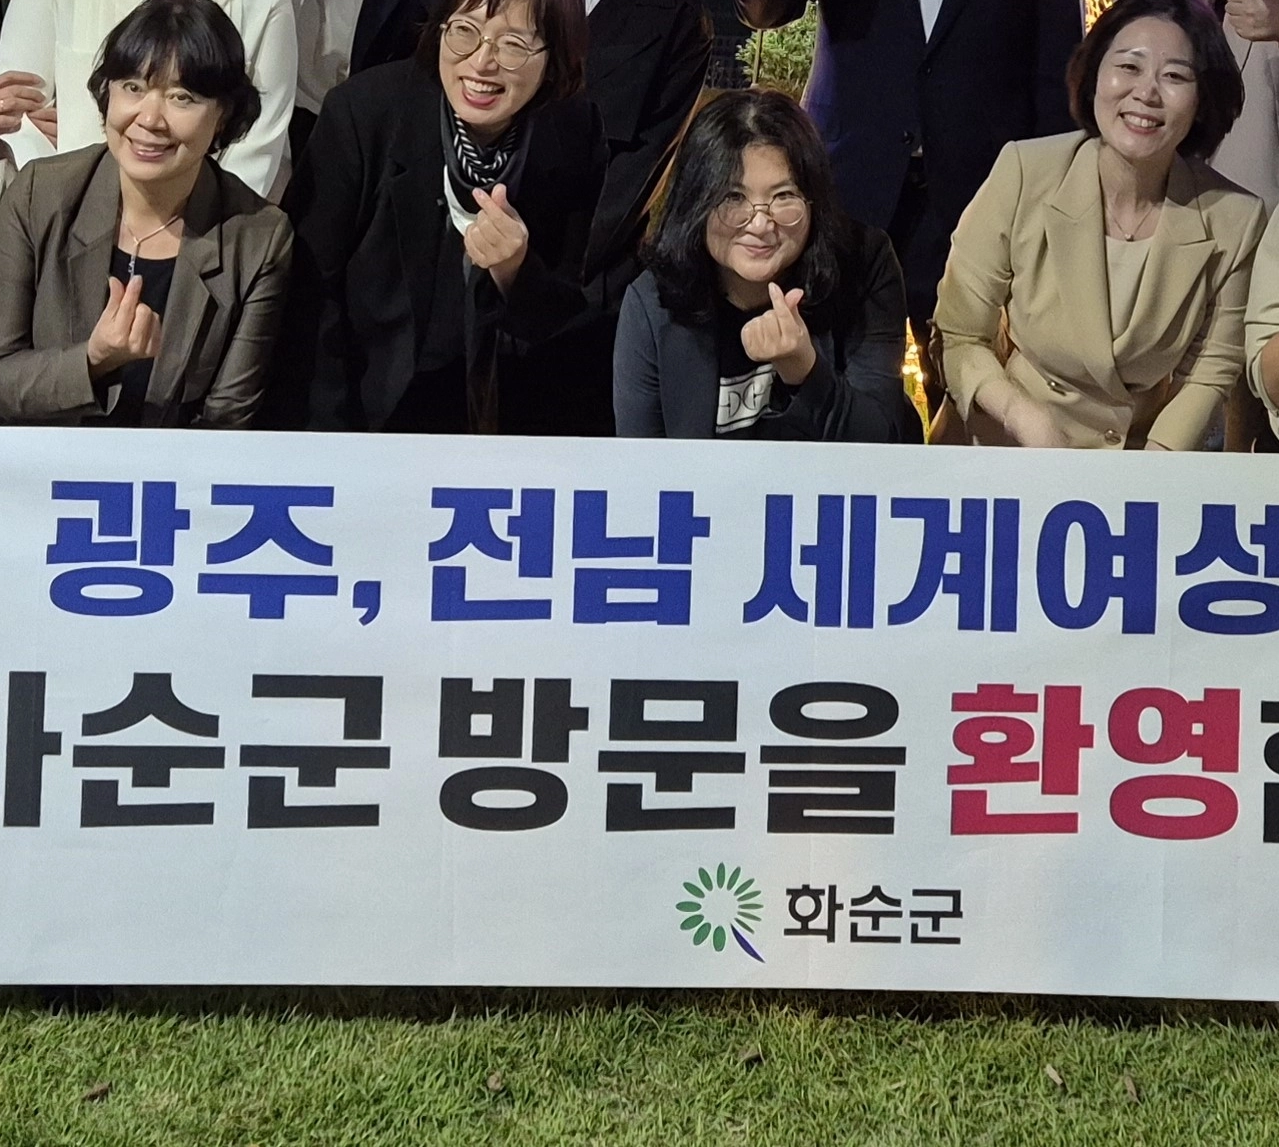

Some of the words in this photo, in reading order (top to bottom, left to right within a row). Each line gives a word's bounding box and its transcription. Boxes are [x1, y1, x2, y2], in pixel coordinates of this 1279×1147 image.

[46, 480, 382, 626] 광주,
[428, 487, 711, 626] 전남
[438, 677, 907, 835] 방문을
[783, 884, 963, 945] 화순군
